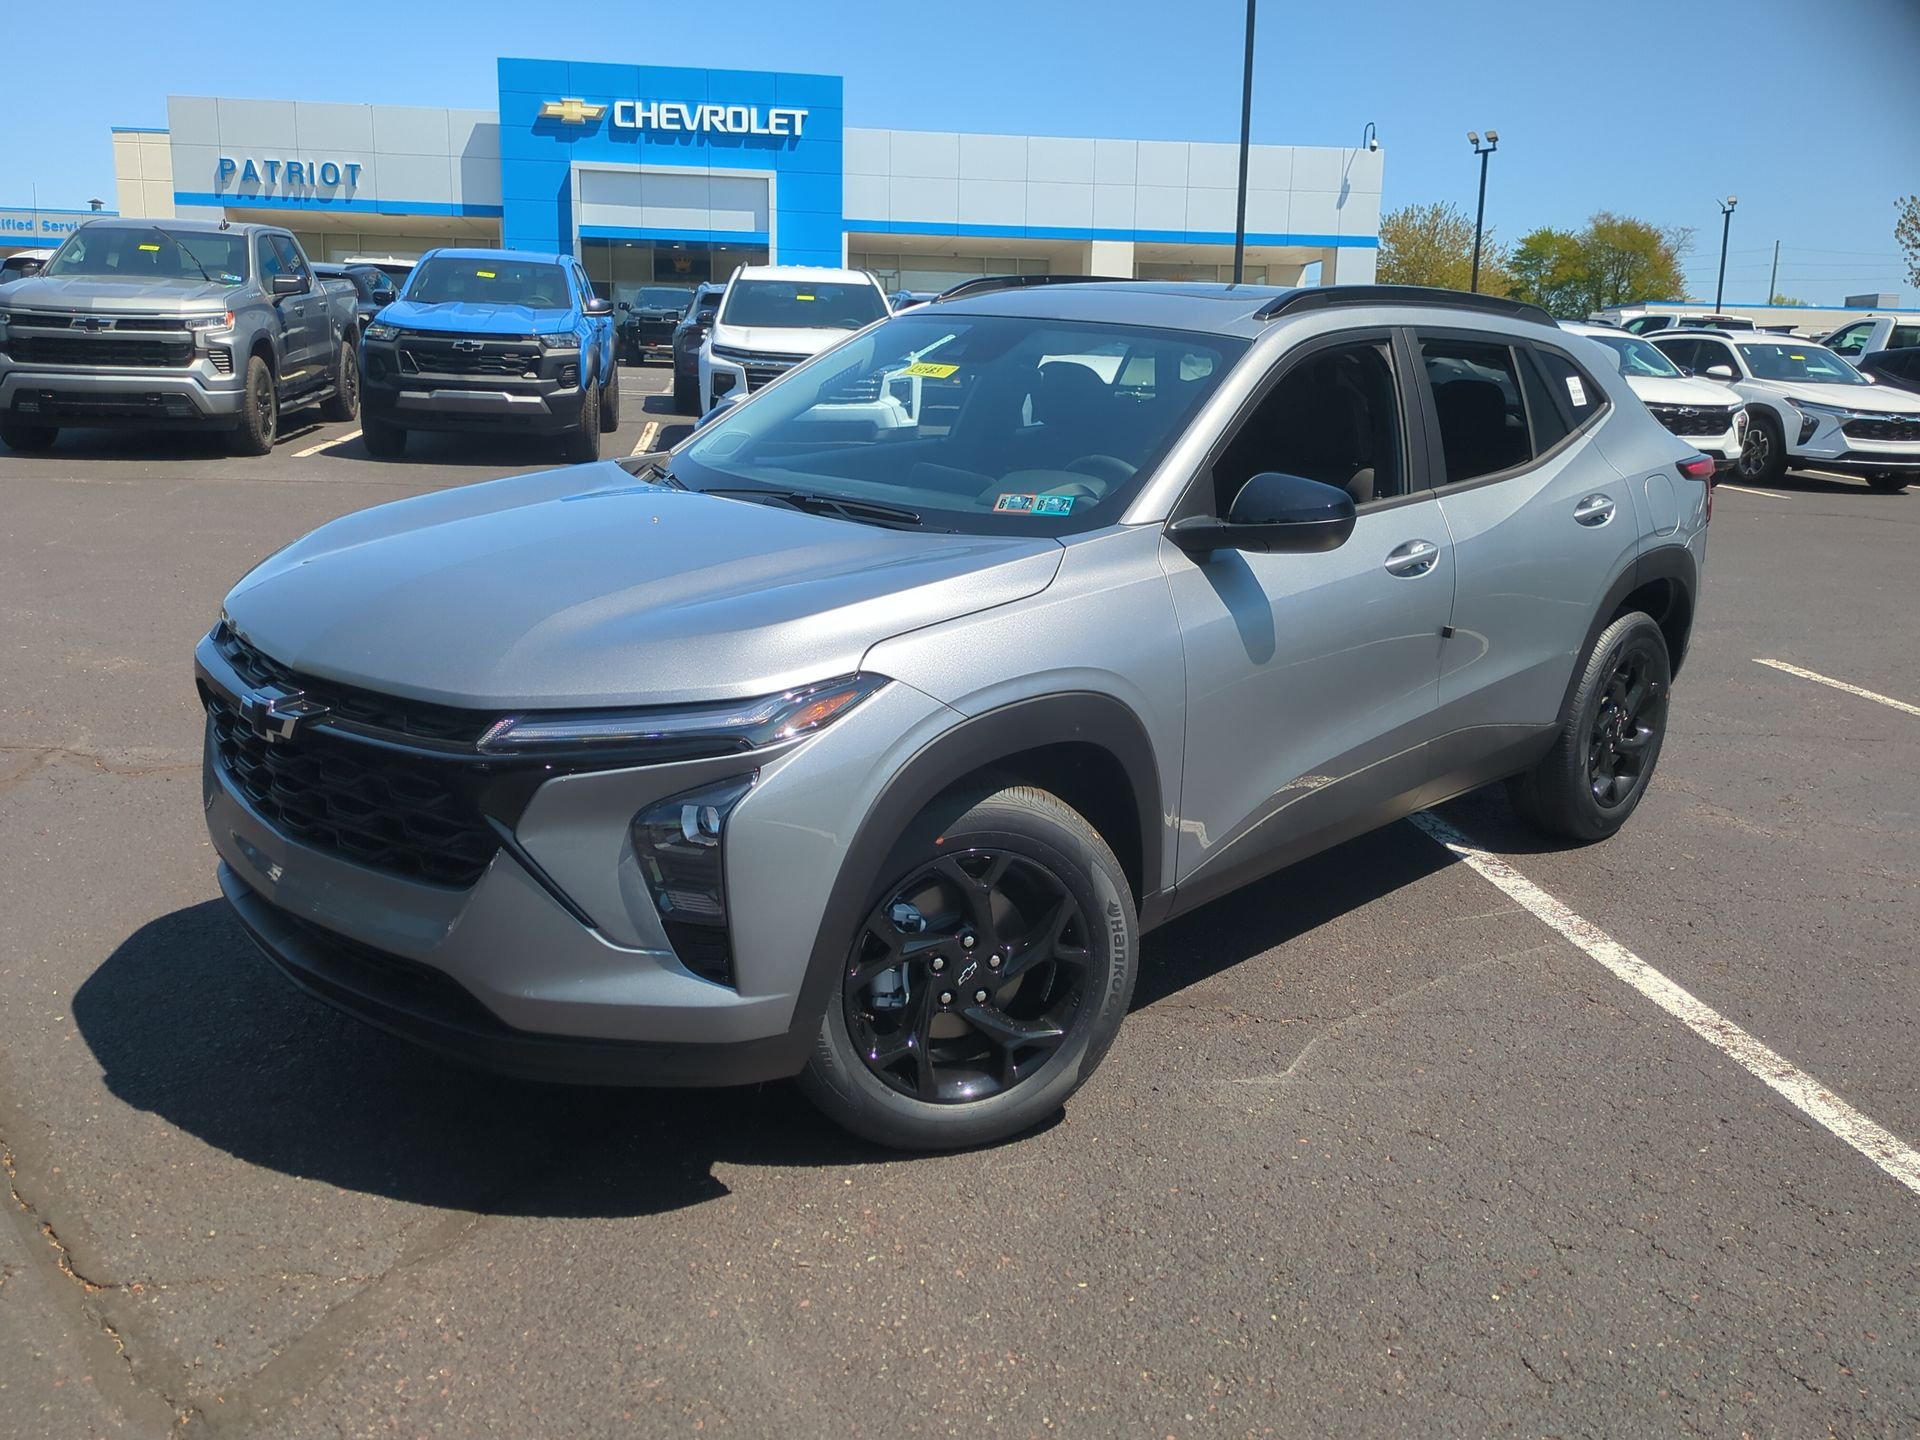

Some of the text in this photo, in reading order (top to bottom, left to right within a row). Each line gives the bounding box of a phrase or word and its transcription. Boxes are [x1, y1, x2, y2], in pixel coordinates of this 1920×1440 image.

[614, 100, 809, 136] CHEVROLET
[219, 158, 362, 187] PATRIOT
[0, 218, 80, 232] ified Servi
